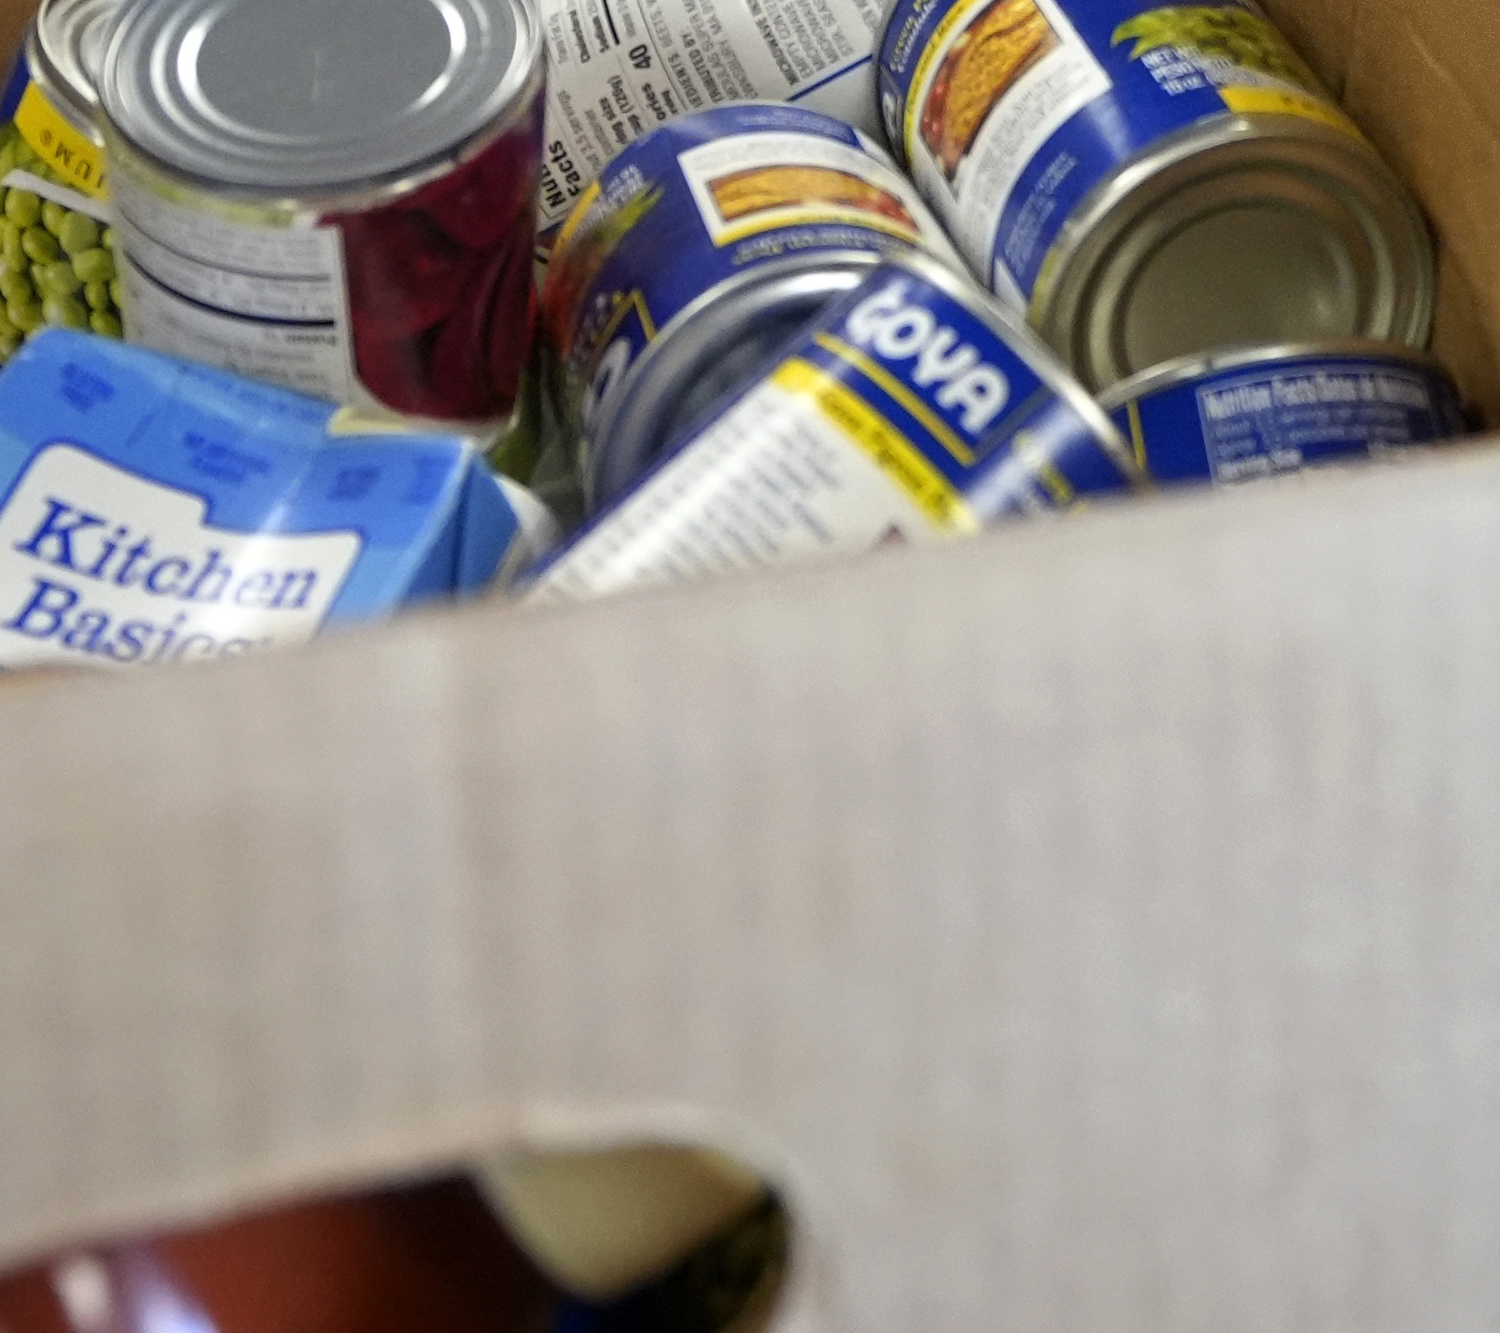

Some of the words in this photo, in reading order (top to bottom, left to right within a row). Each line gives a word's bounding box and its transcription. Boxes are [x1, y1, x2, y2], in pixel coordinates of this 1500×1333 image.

[627, 42, 654, 73] 40
[754, 15, 799, 86] MICROWAVE
[781, 1, 827, 72] MICROWAVE
[783, 40, 814, 80] EMPTY
[545, 139, 584, 197] Facts
[845, 279, 1011, 435] GOYA
[13, 493, 319, 611] Kitchen
